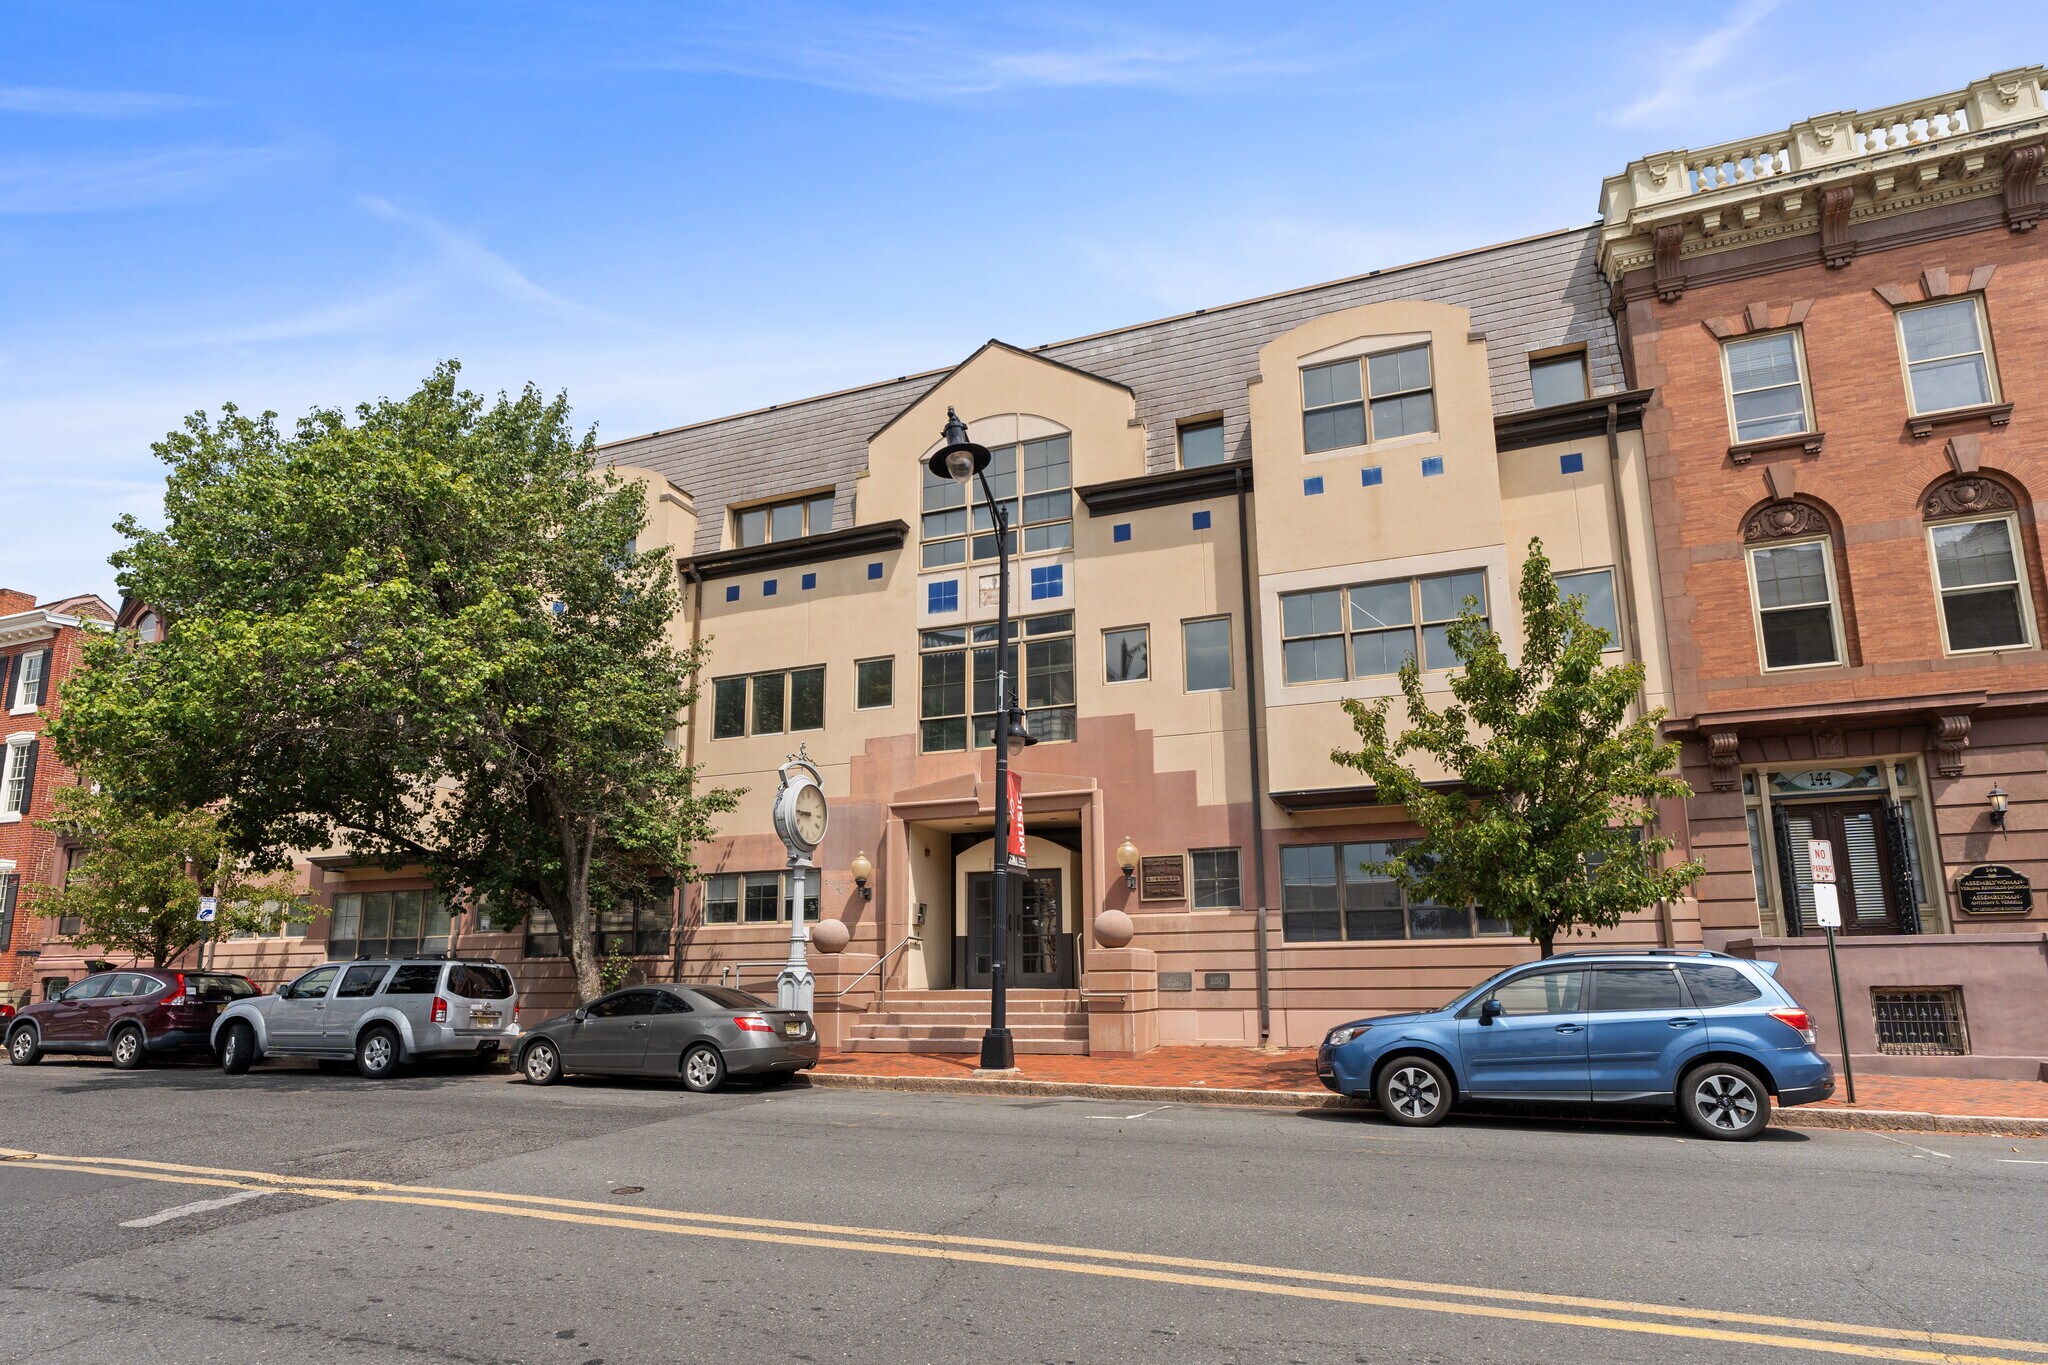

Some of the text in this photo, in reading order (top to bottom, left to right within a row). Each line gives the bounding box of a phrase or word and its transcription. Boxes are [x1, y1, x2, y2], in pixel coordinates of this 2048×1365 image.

[1809, 772, 1832, 786] 144
[1017, 791, 1026, 854] MUSIC
[1815, 849, 1826, 859] NO
[1812, 865, 1833, 873] PARKING
[1210, 976, 1225, 984] 150
